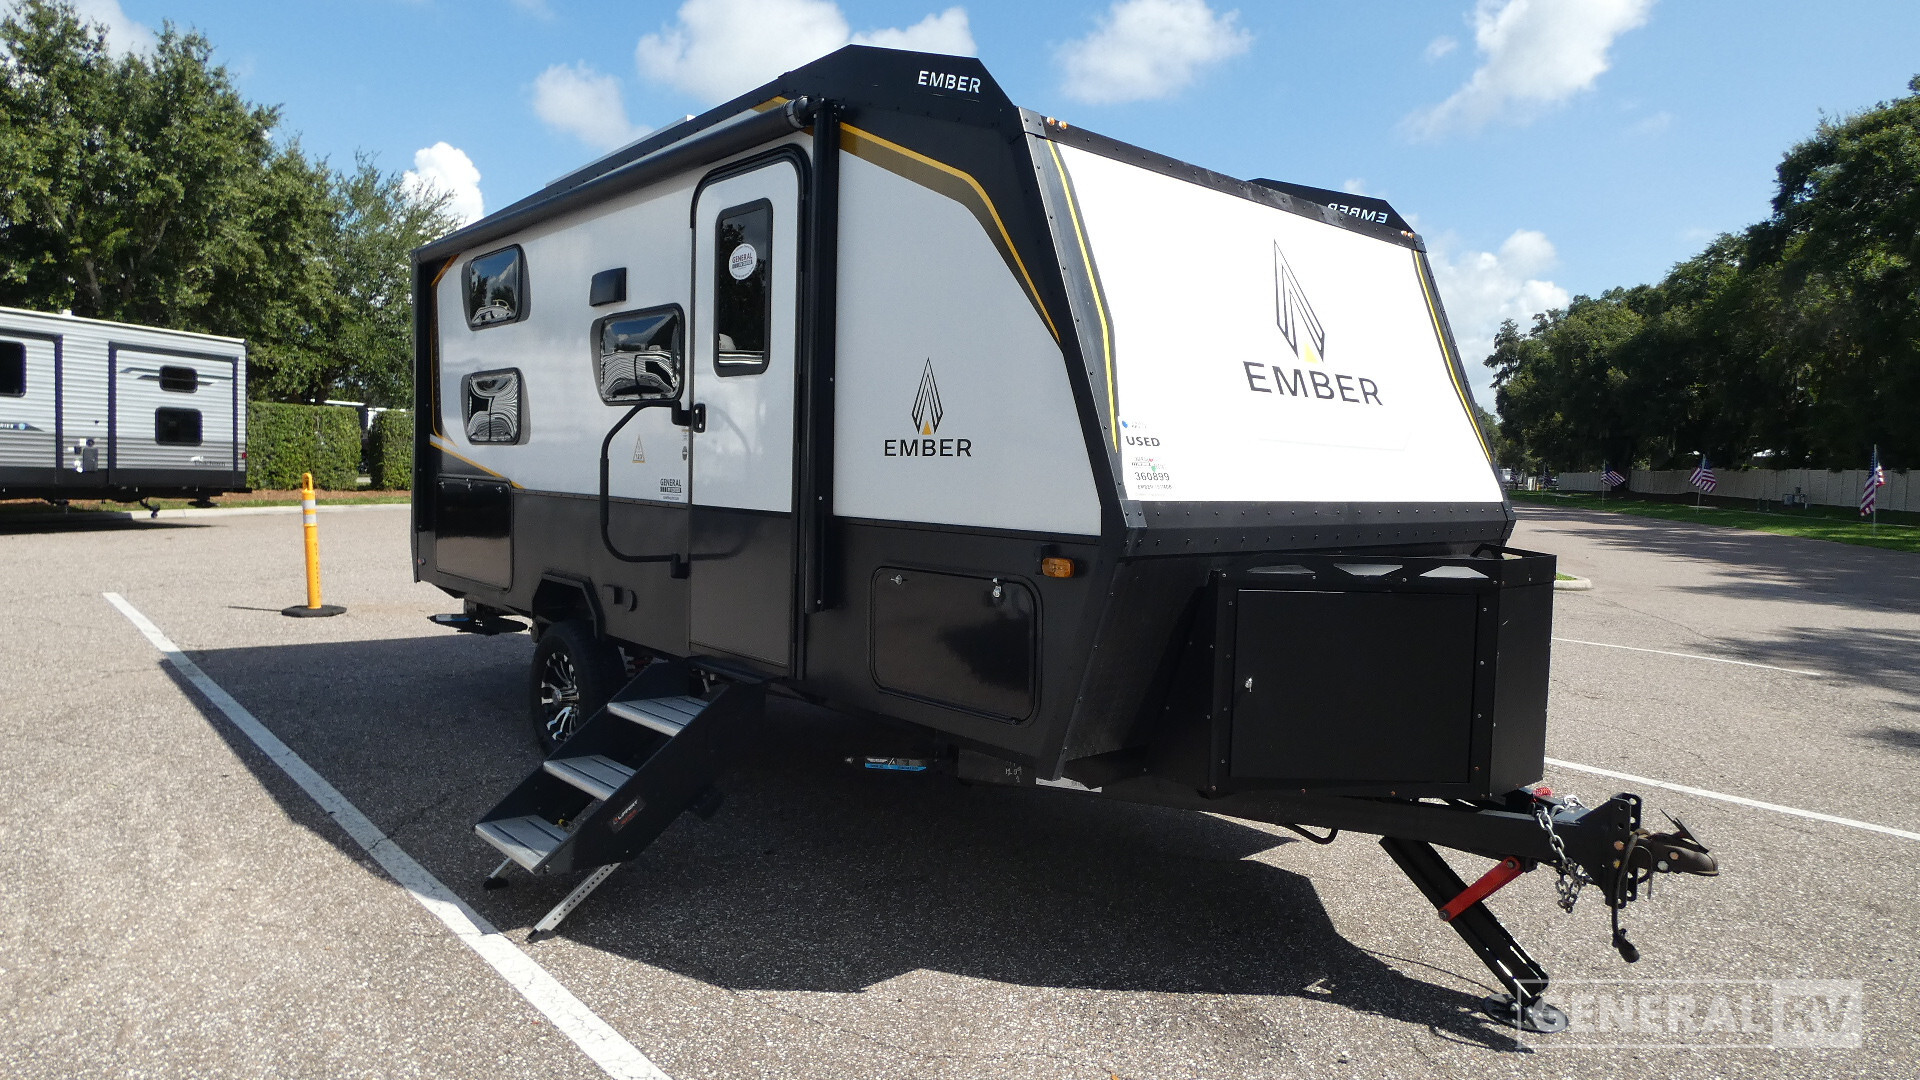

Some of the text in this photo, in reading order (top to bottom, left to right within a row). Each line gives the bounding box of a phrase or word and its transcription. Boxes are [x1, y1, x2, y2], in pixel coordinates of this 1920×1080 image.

[917, 69, 981, 94] EMBER
[732, 252, 753, 264] GENERAL
[1242, 360, 1384, 407] EMBER
[1125, 435, 1161, 447] USED
[884, 438, 972, 457] EMBER
[660, 478, 682, 487] GENERAL
[1134, 471, 1170, 482] 360899
